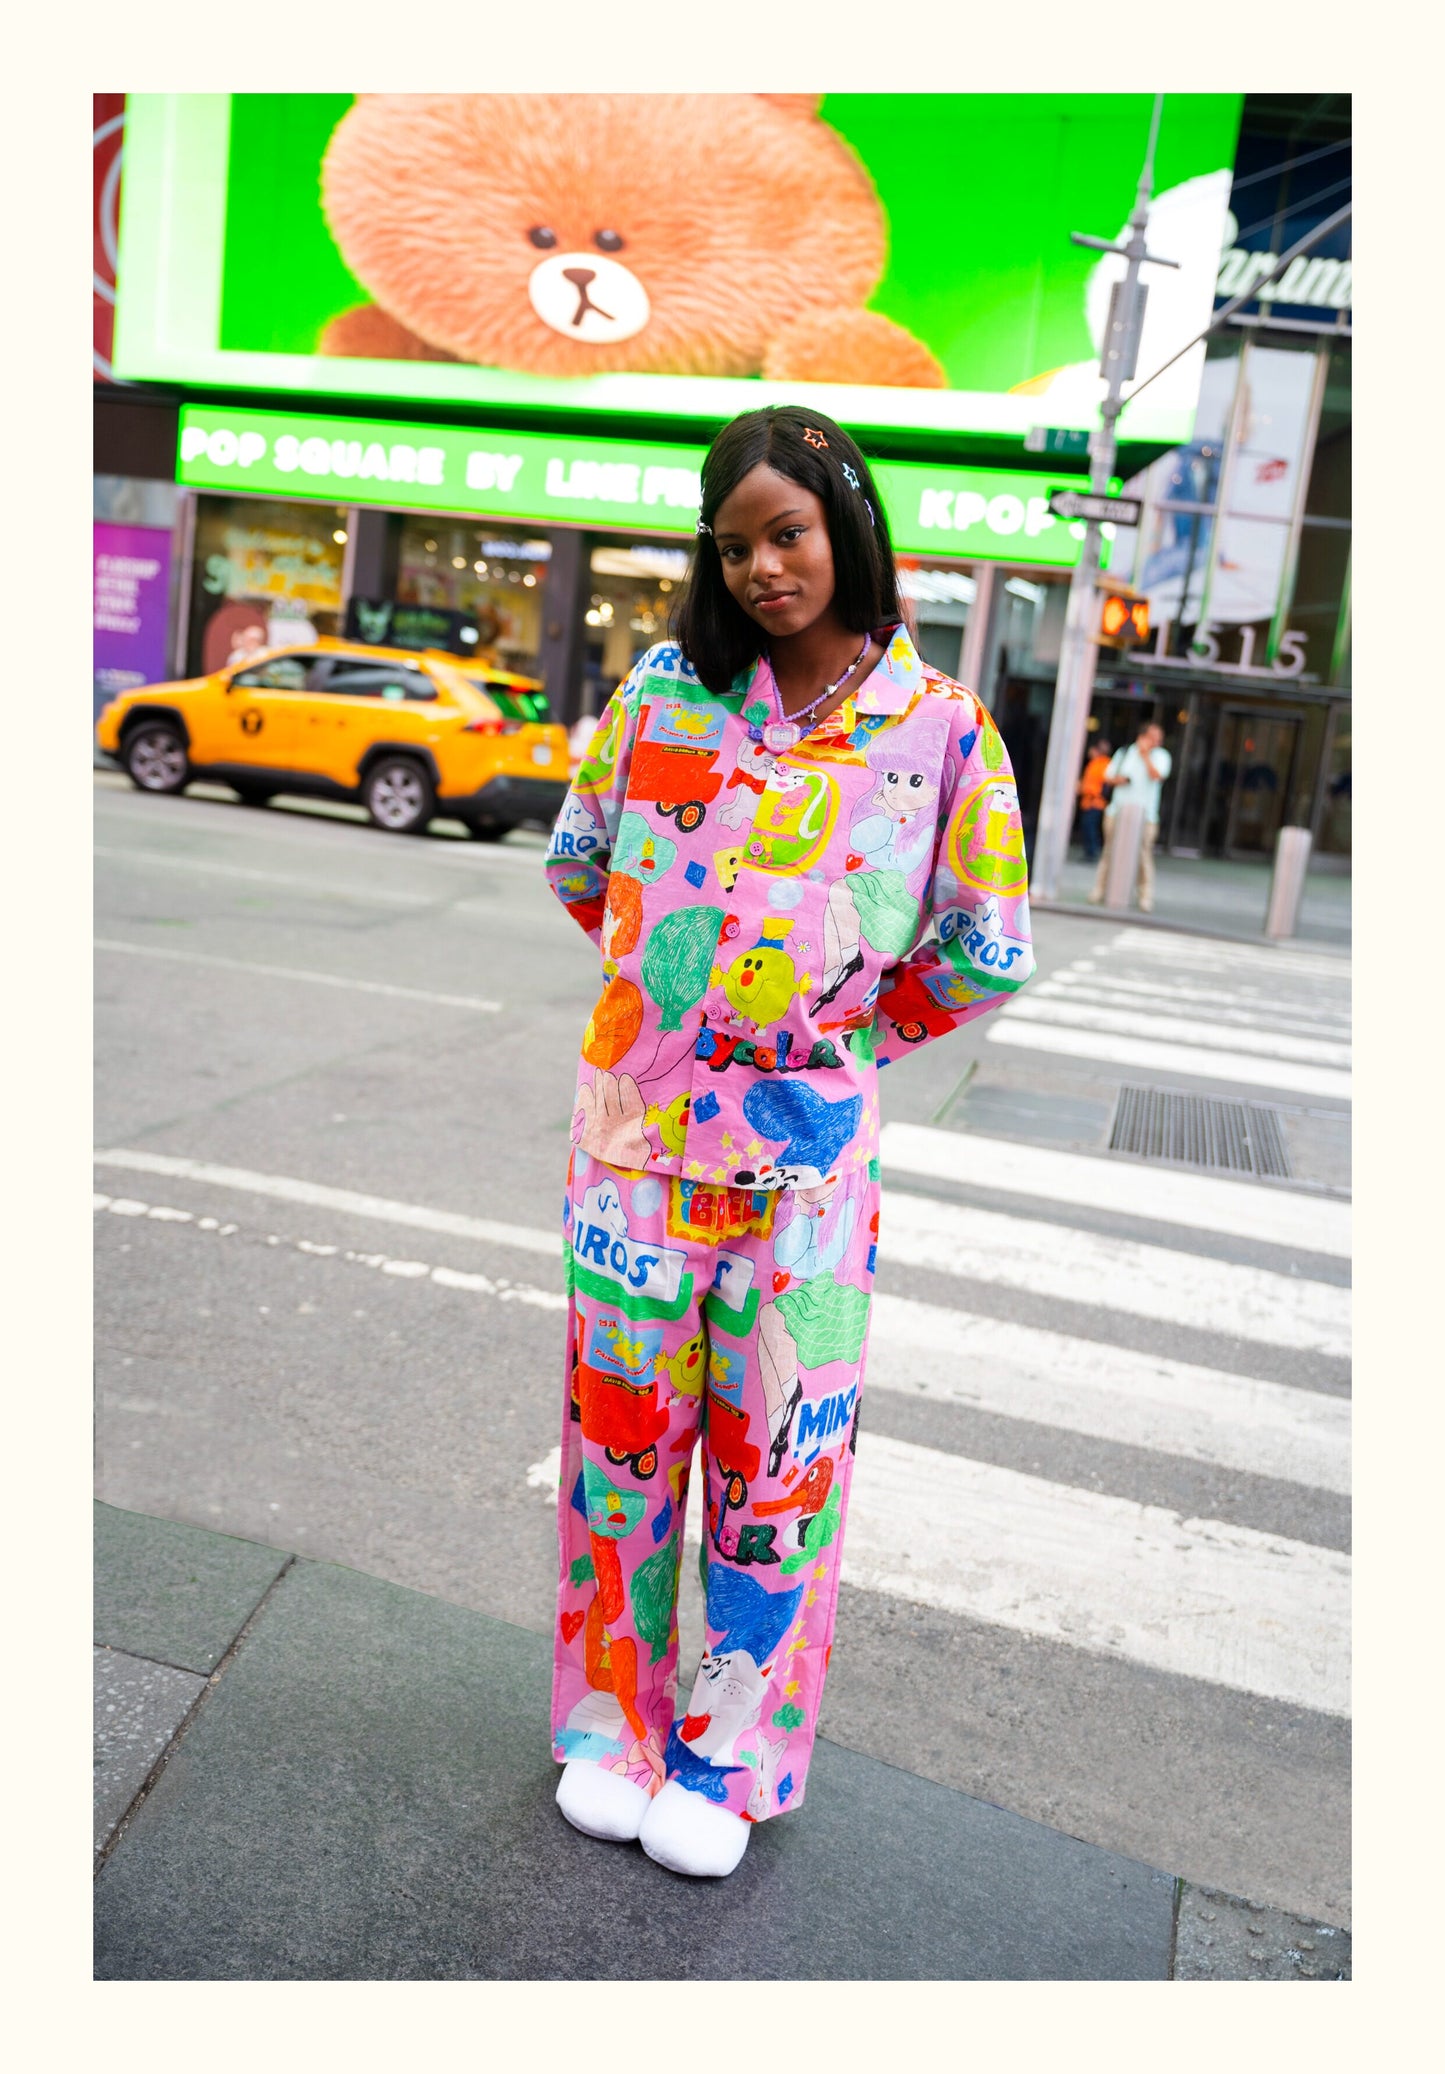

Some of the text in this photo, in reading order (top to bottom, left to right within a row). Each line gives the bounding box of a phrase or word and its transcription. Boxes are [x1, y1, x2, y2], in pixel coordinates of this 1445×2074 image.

[180, 427, 266, 468] POP
[273, 434, 445, 486] SQUARE
[466, 451, 523, 492] BY
[1155, 620, 1308, 678] 1515
